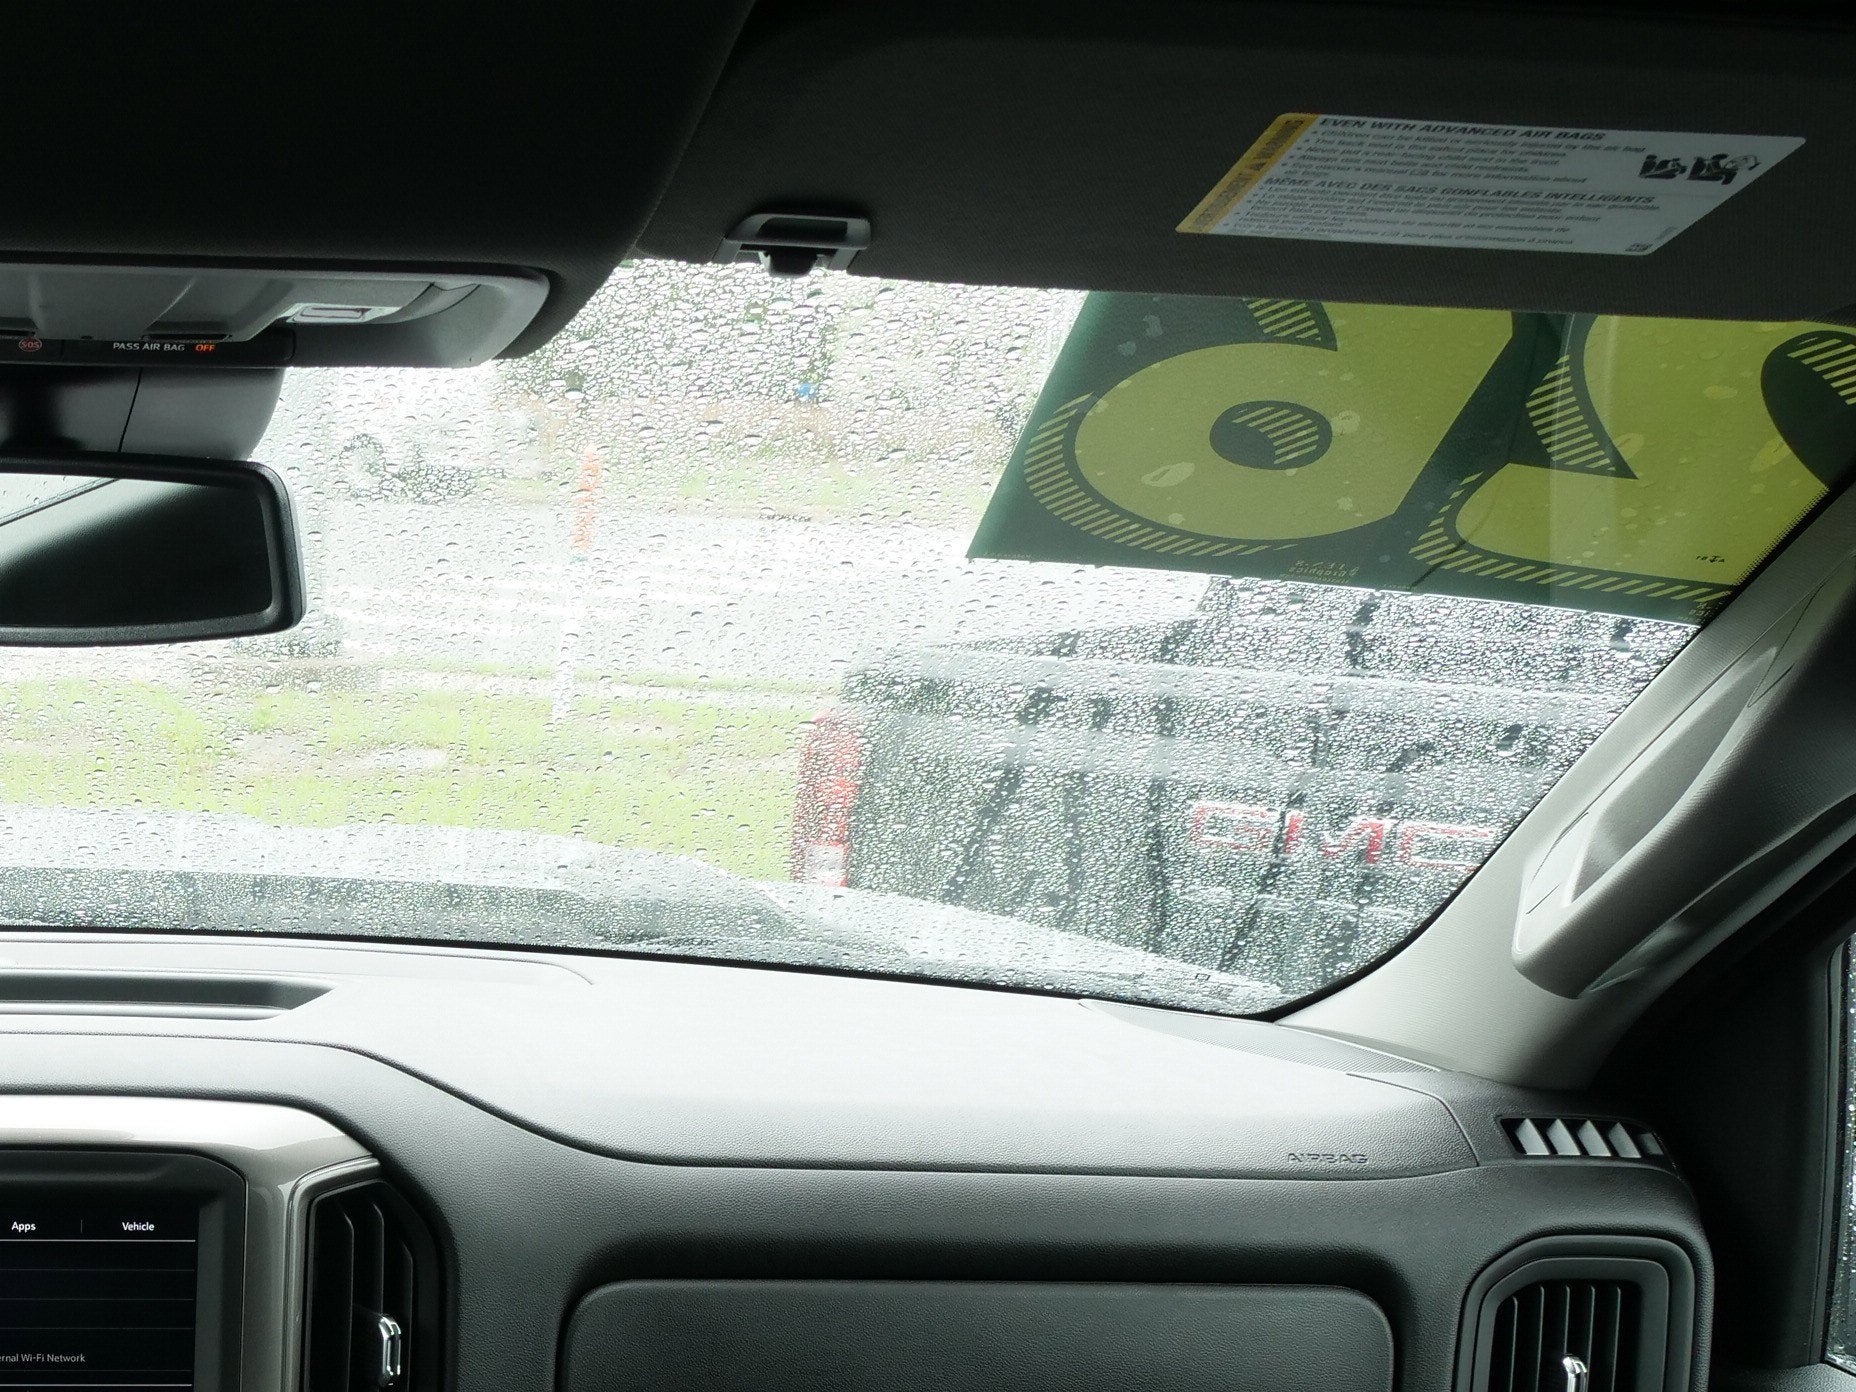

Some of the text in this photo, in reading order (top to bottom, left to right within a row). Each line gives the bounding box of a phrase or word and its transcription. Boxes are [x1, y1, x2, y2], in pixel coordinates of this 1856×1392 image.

[1317, 117, 1369, 127] EVEN
[1367, 120, 1419, 130] WITH
[1417, 123, 1520, 136] ADVANCED
[1517, 129, 1554, 138] AIR
[1552, 130, 1608, 141] BAGS
[21, 340, 40, 349] SOS
[112, 342, 216, 352] PASS AIR BAG OFF
[1191, 801, 1493, 872] GMC
[1287, 1153, 1368, 1163] AIRBAG
[11, 1221, 36, 1233] Apps
[121, 1221, 155, 1232] Vehicle
[21, 1353, 45, 1363] Wi-Fi
[47, 1353, 86, 1363] Network
